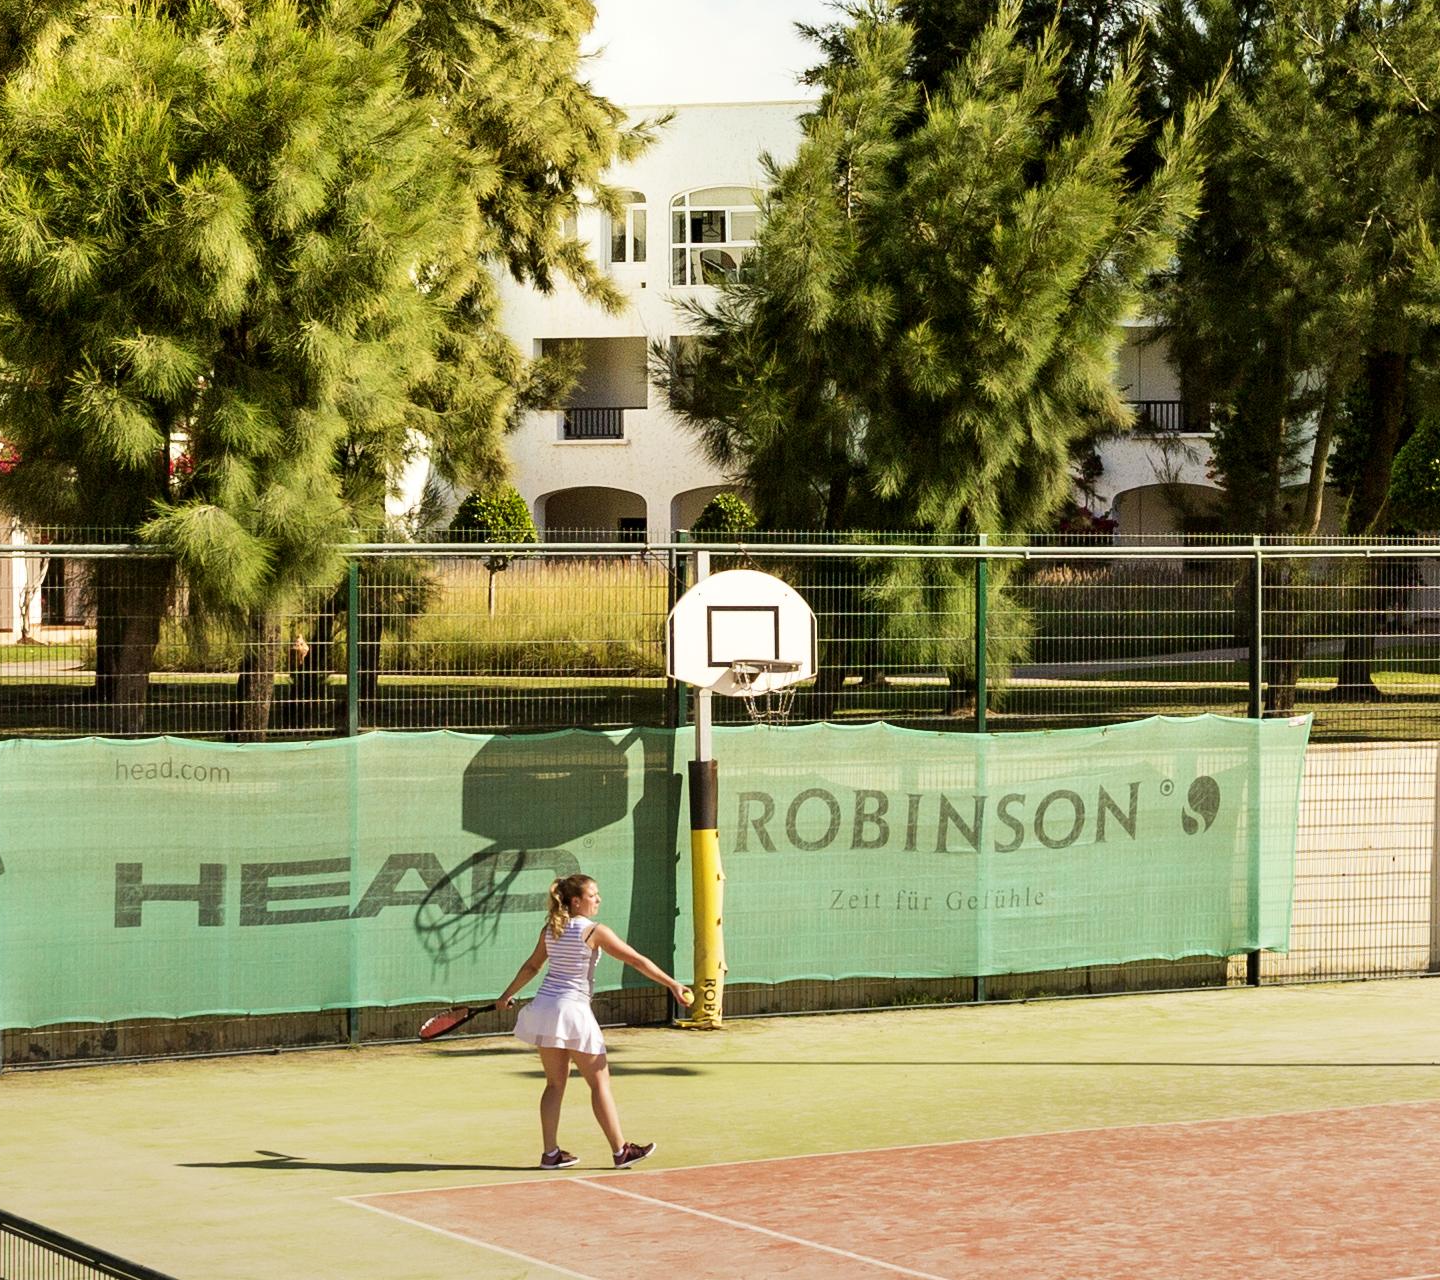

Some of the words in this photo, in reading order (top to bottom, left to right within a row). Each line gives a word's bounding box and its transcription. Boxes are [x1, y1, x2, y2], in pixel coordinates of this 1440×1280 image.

[115, 756, 231, 784] head.com
[733, 781, 1142, 854] ROBINSON
[114, 848, 582, 928] HEAD
[829, 887, 881, 910] Zeit
[896, 889, 932, 911] für
[946, 886, 1045, 911] Gefühle
